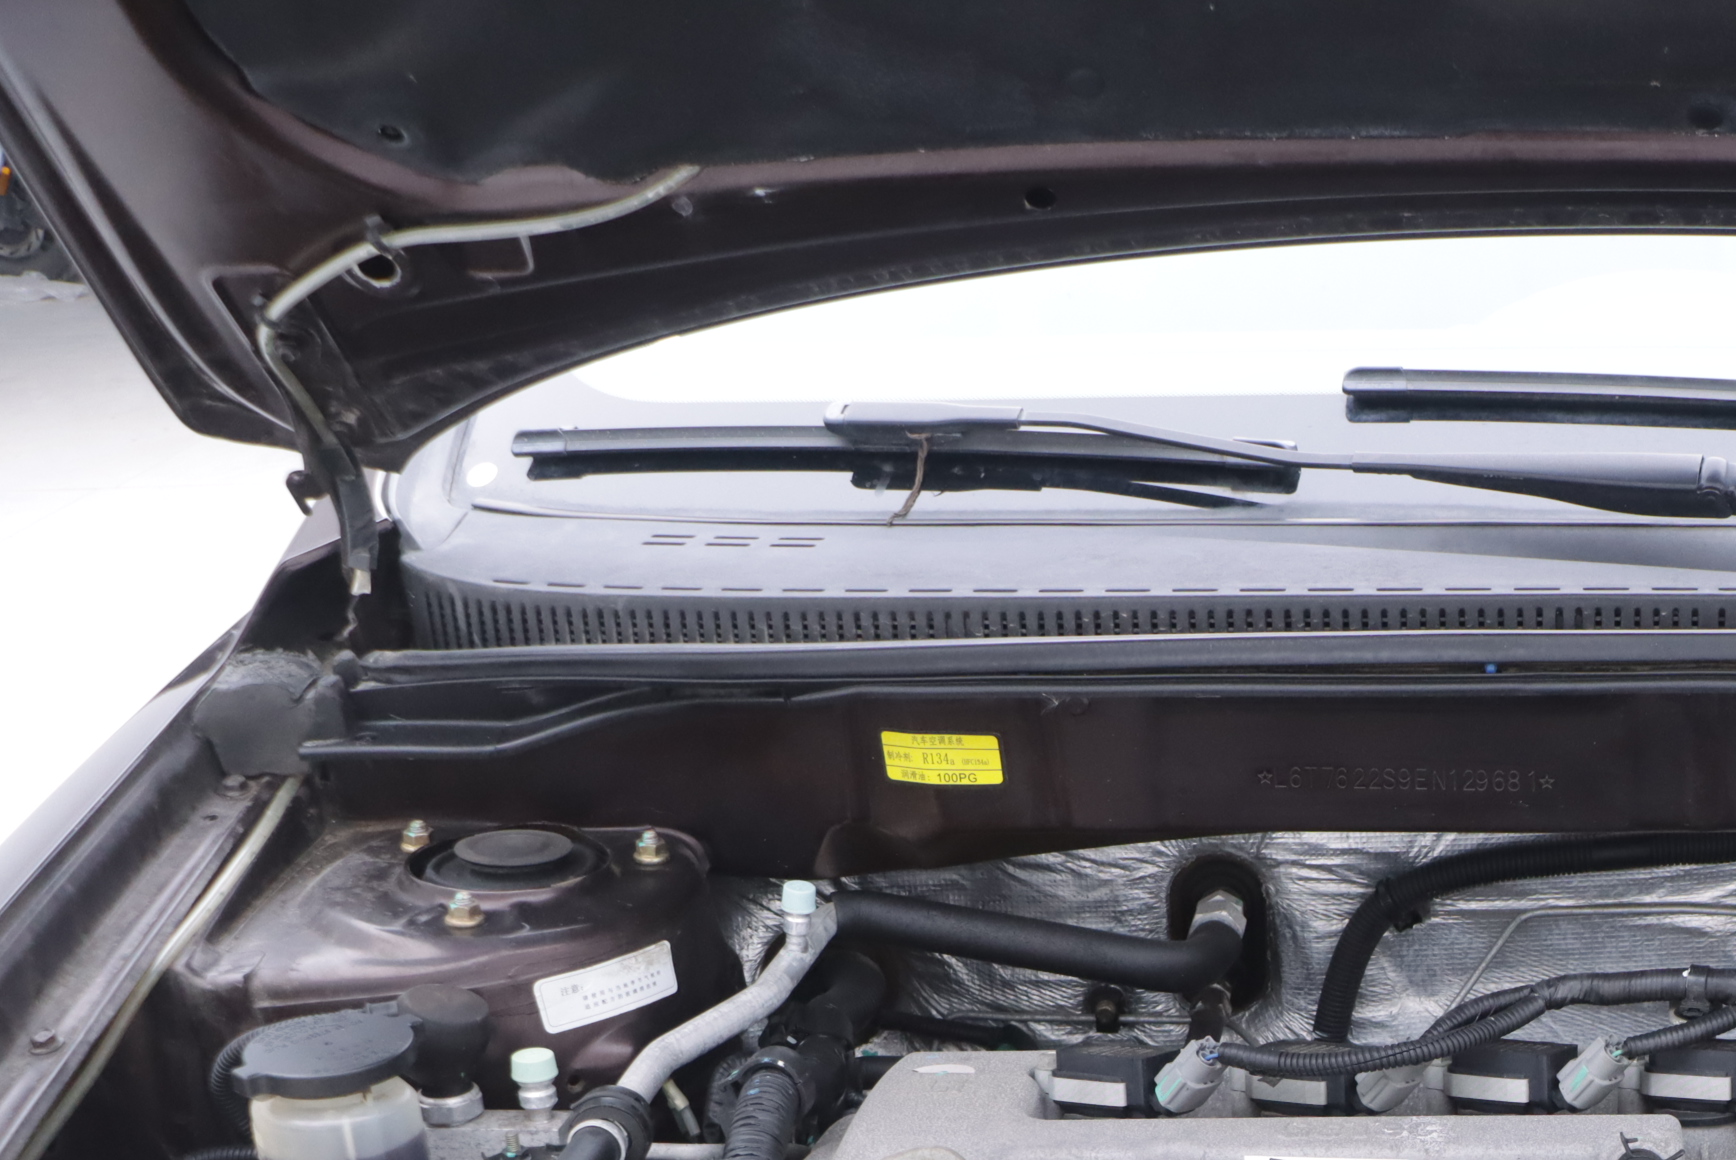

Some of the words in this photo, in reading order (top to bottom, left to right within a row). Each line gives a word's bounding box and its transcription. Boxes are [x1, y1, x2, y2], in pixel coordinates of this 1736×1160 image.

[911, 735, 964, 746] 汽车空调系统
[922, 752, 956, 766] R134a
[936, 772, 978, 784] 100PG
